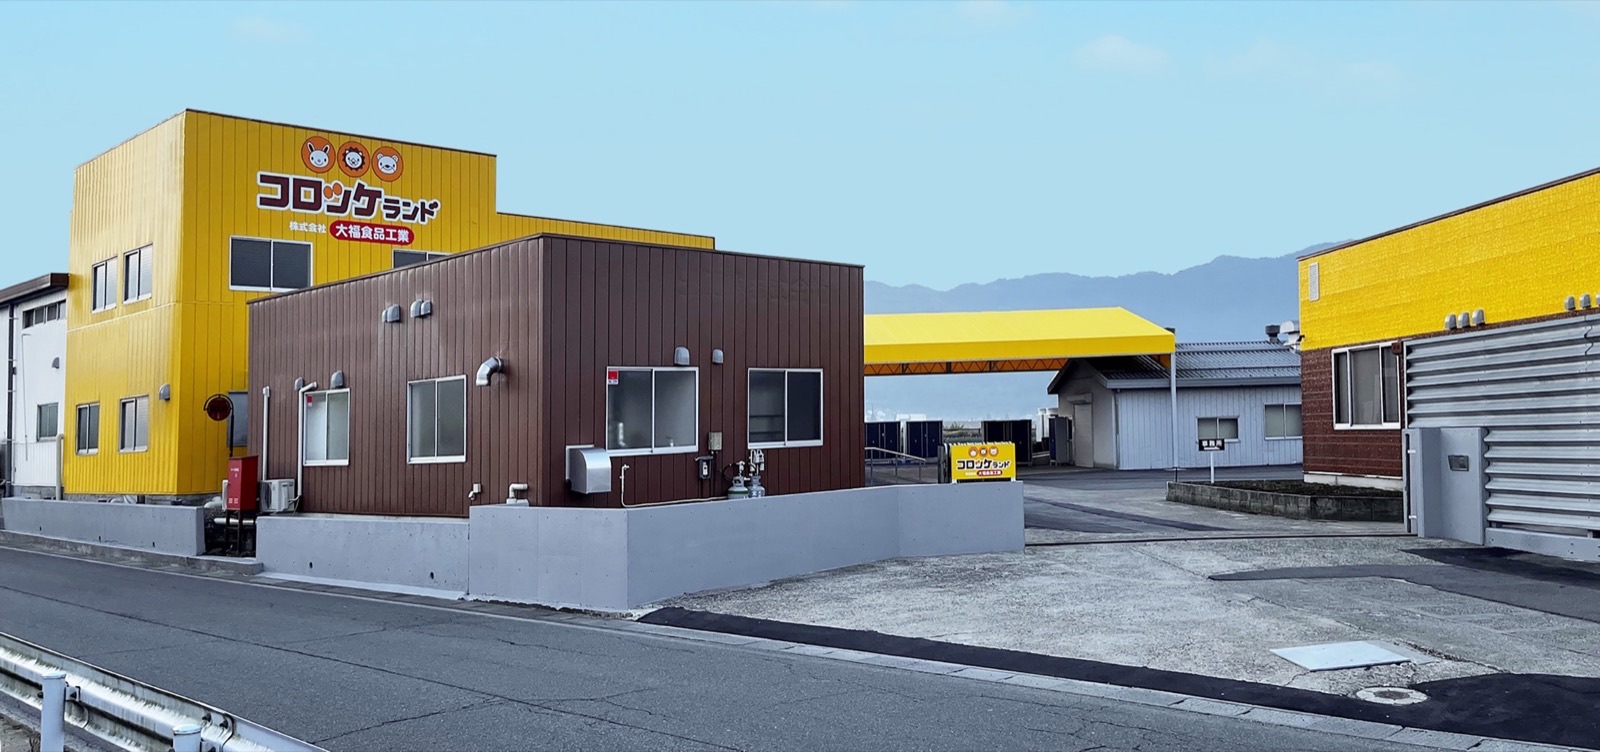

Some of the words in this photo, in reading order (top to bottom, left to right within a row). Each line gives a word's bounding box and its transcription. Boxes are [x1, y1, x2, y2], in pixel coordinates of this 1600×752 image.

[258, 172, 440, 224] コロッケランド
[289, 221, 327, 234] 株式会社
[335, 224, 410, 243] 大福食品工業
[957, 458, 1010, 470] コロッケランド
